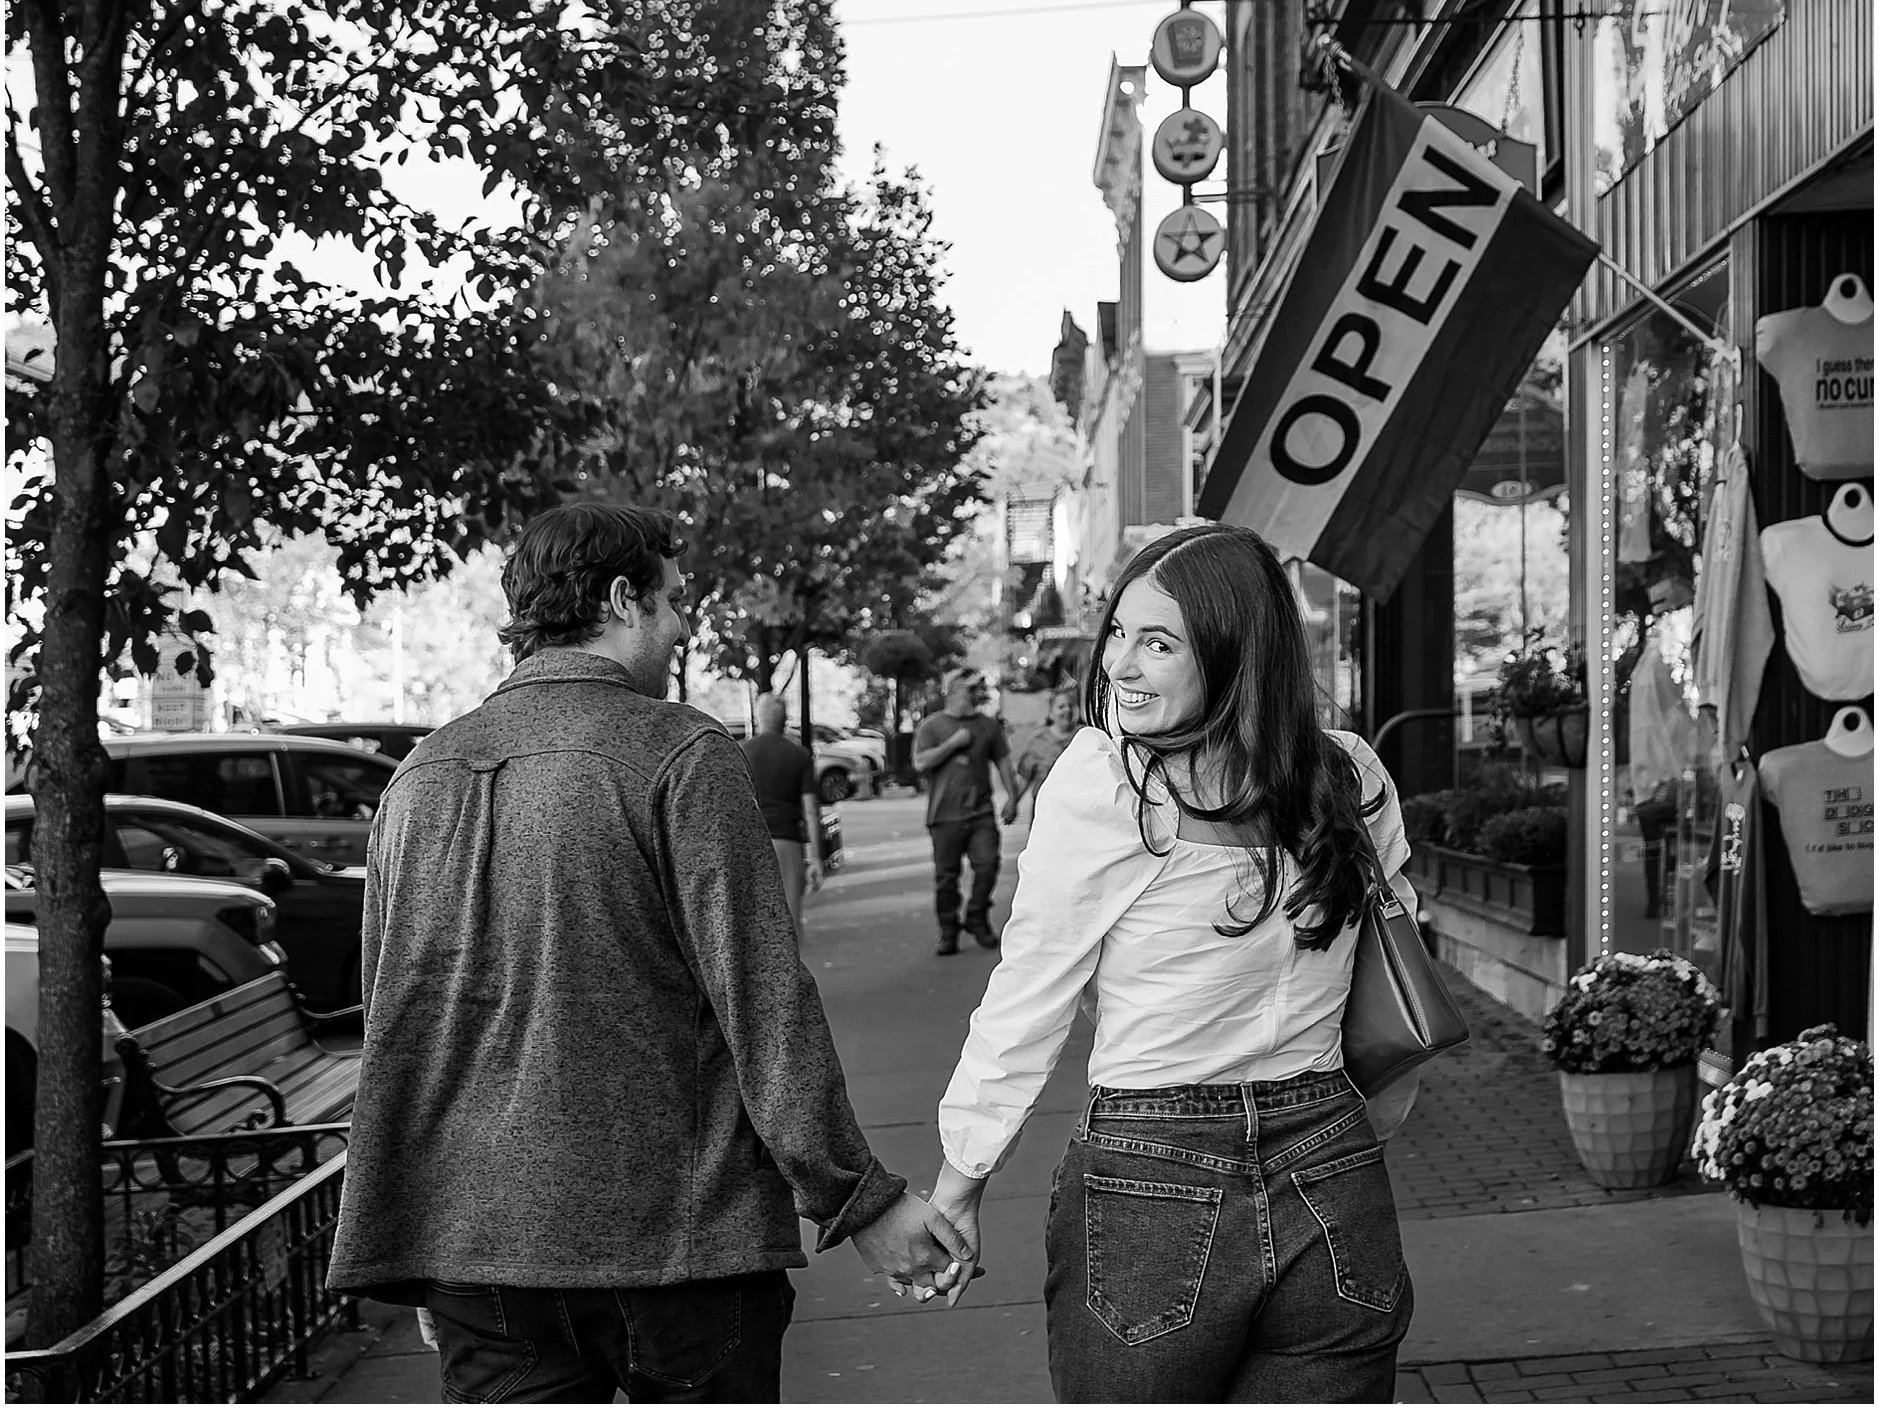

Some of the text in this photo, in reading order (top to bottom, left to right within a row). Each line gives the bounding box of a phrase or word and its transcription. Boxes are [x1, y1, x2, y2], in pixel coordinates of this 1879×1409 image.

[1269, 144, 1501, 486] OPEN
[1822, 359, 1852, 376] guess
[1816, 378, 1841, 401] no
